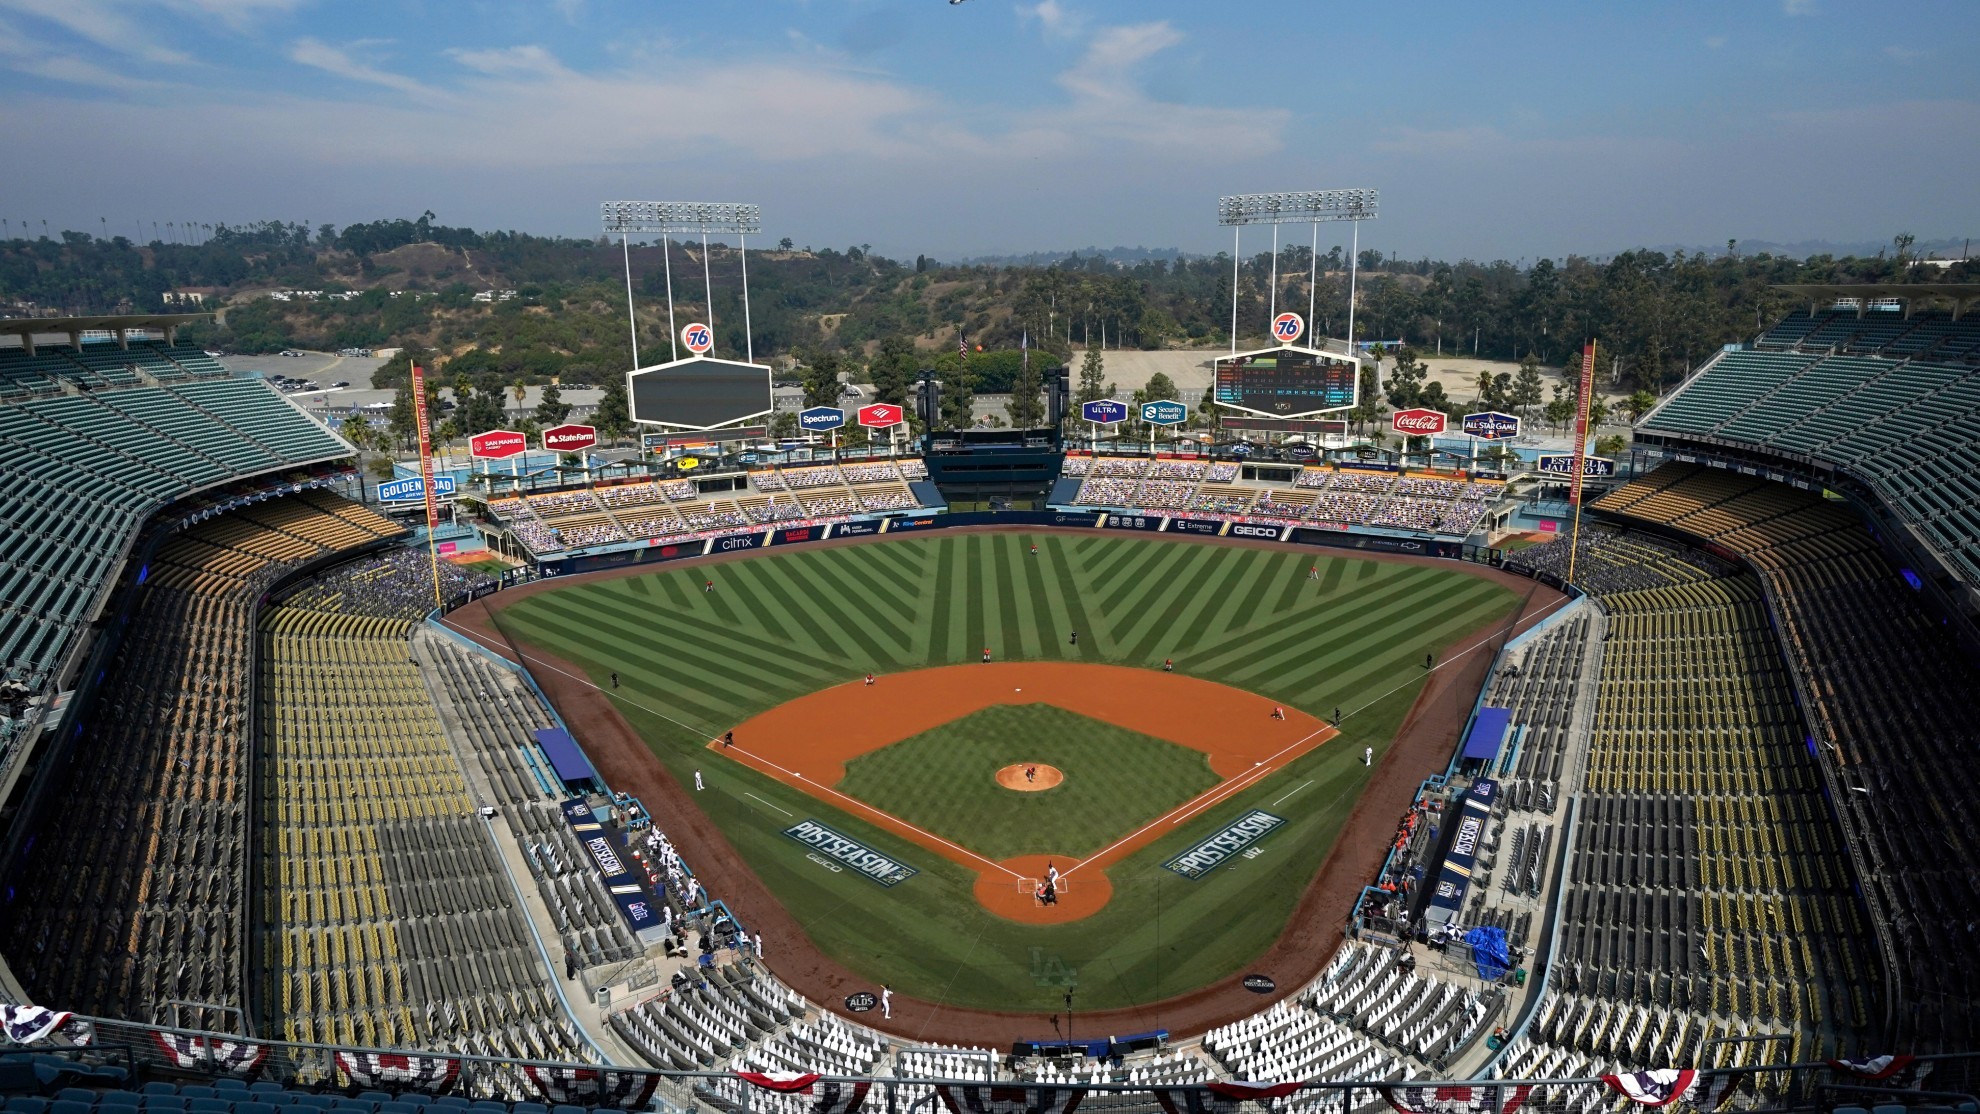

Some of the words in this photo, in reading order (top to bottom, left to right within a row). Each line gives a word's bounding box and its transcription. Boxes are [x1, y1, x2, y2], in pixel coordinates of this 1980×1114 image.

[688, 329, 709, 346] 76
[1277, 319, 1298, 336] 76
[1583, 354, 1592, 374] BETTER
[415, 376, 424, 394] BETTER
[1582, 374, 1590, 384] FLY
[1578, 386, 1588, 422] Emirates
[419, 408, 430, 444] Emirates
[804, 414, 839, 424] Spectrum
[1397, 414, 1440, 430] Coca-Cola
[1680, 433, 1726, 445] DODGER
[1735, 442, 1783, 456] STADIUM
[1571, 463, 1581, 498] Emirates
[1576, 432, 1584, 451] BETTER
[383, 481, 422, 498] GOLDEN
[428, 485, 438, 521] Emirates
[1234, 526, 1277, 537] GEICO
[723, 535, 752, 550] citrix
[1178, 812, 1281, 871] POSTSEASON
[1454, 820, 1480, 856] POSTSEASON
[587, 837, 623, 872] POSTSEASON
[787, 822, 900, 878] POSTSEASON
[806, 853, 843, 873] GEICO
[1028, 946, 1078, 986] LA
[850, 998, 874, 1006] ALDS
